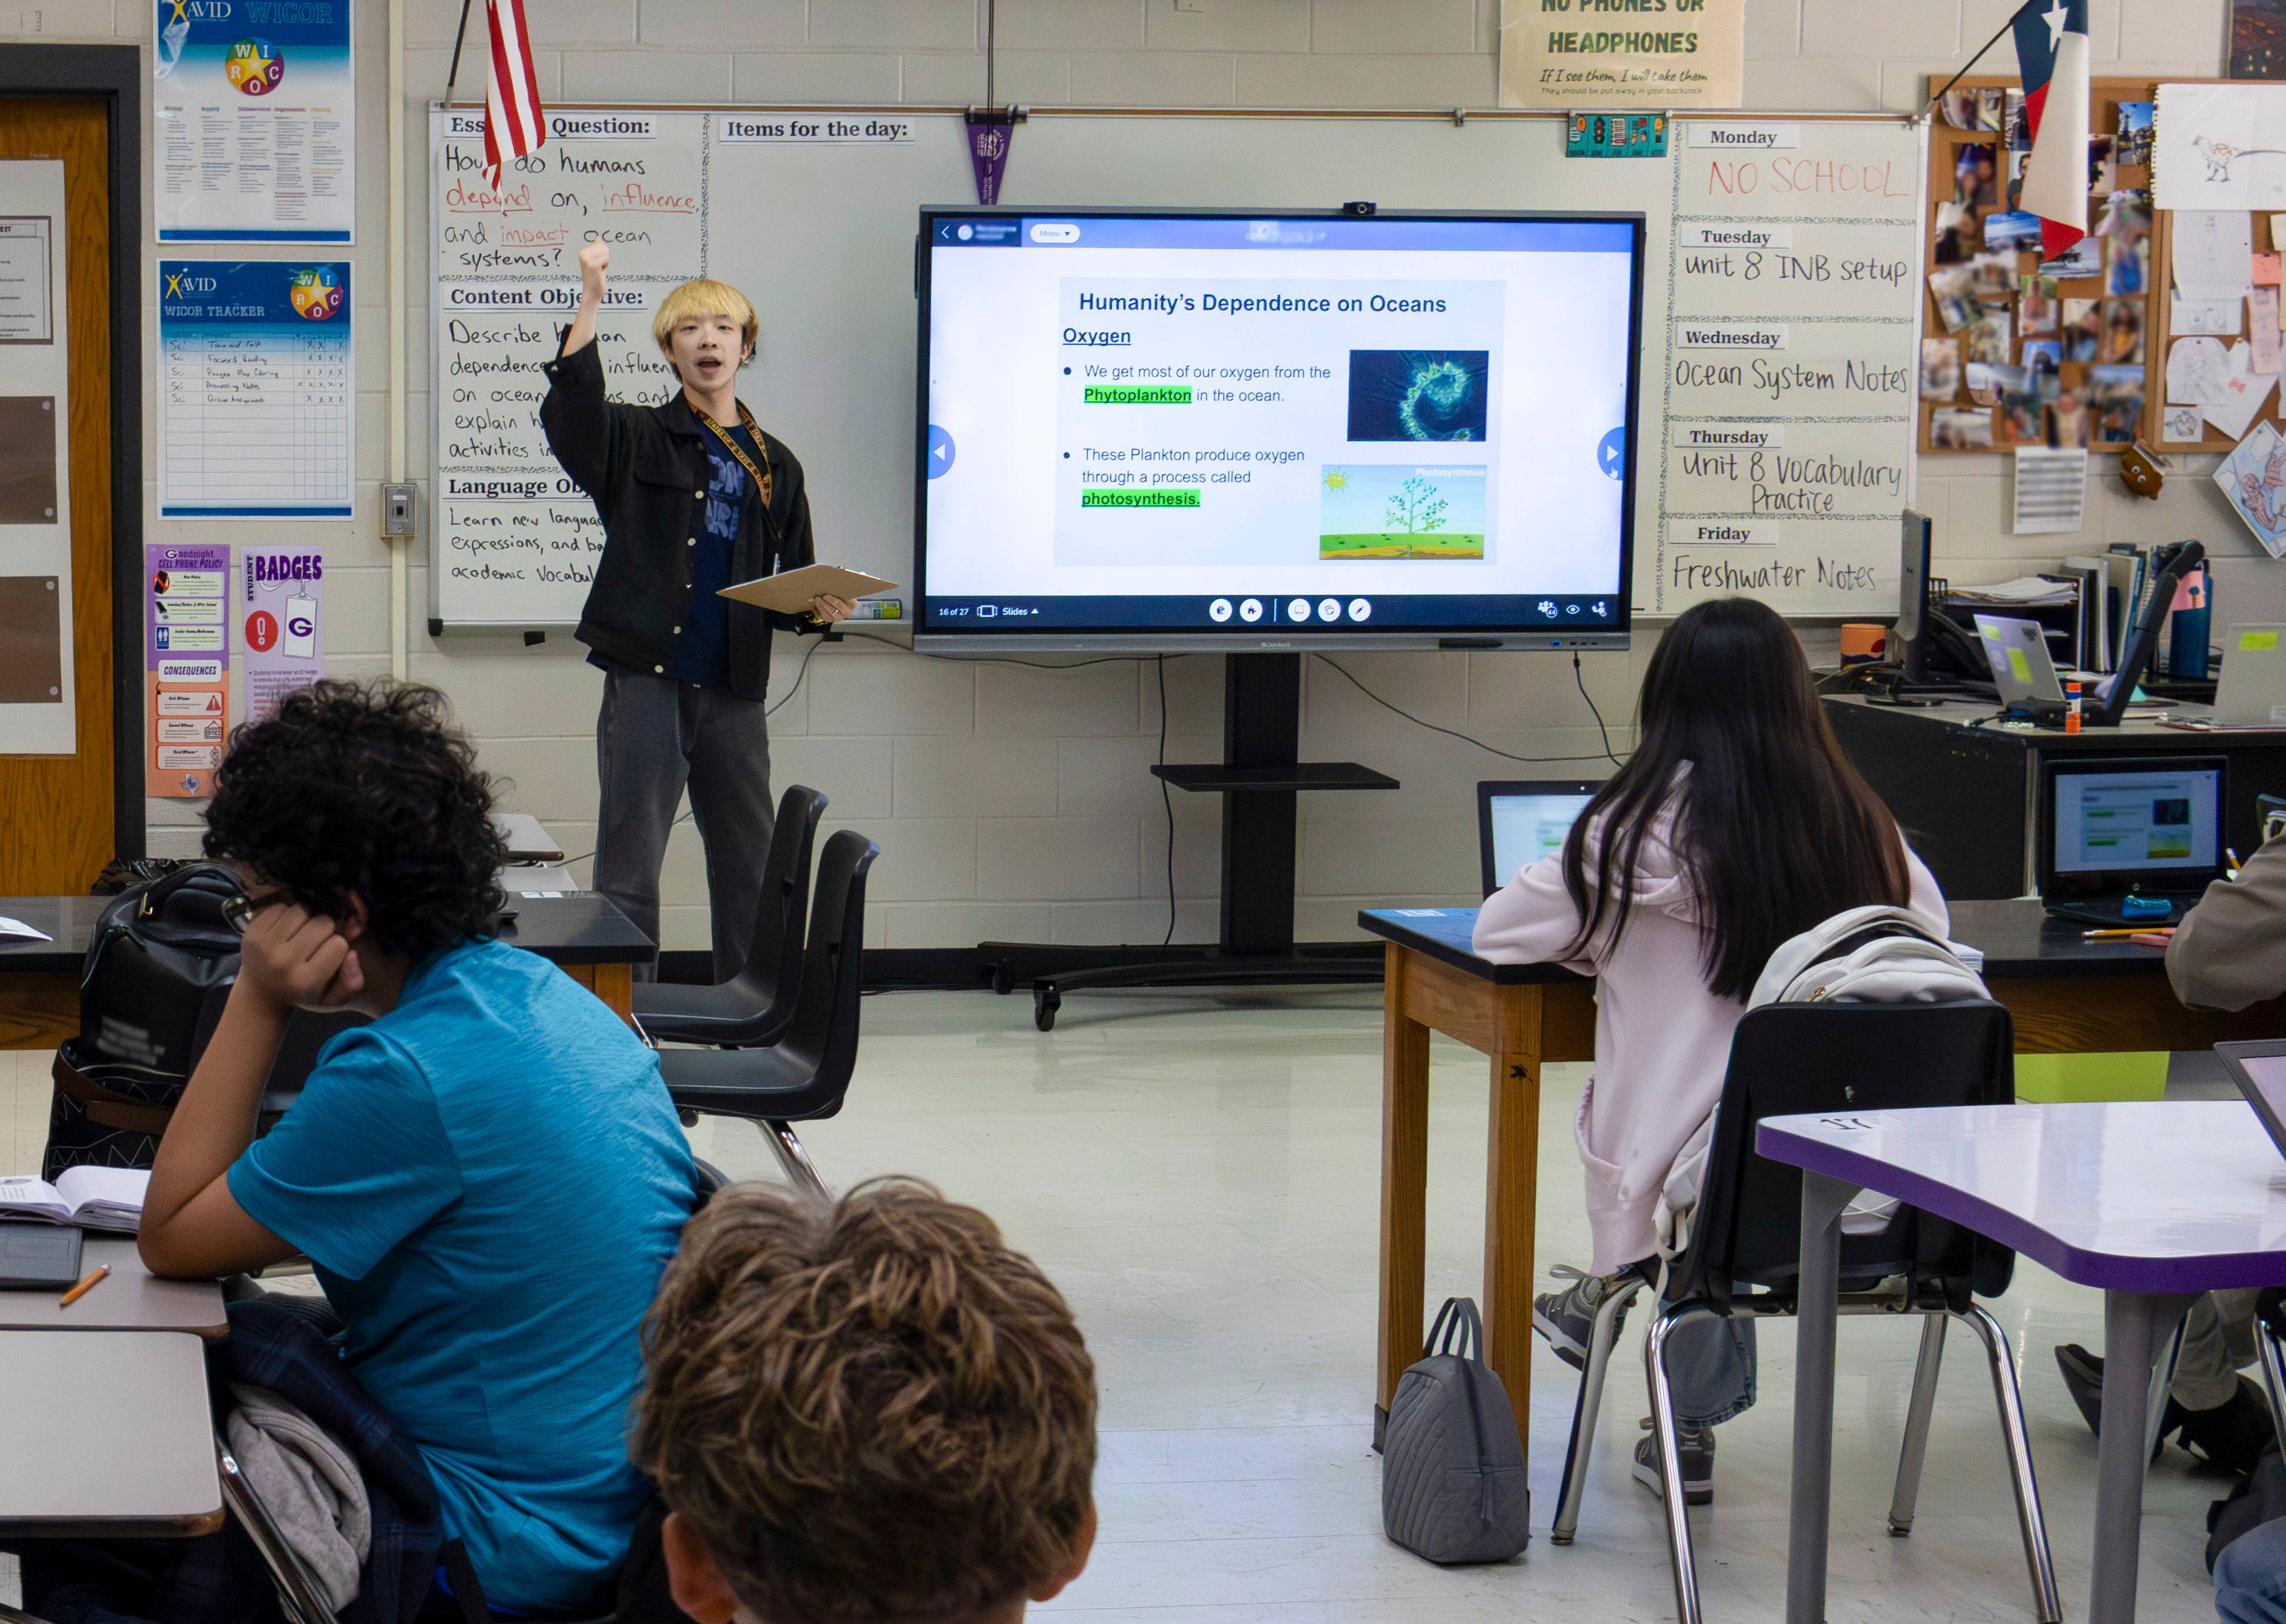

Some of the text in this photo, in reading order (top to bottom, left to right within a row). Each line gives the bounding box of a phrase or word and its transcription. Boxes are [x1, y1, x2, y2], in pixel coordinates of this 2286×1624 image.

[187, 1, 232, 18] AVID
[245, 2, 333, 24] WICOR
[1548, 32, 1698, 53] HEADPHONES
[1631, 69, 1650, 80] will
[1653, 70, 1676, 81] take
[1680, 69, 1707, 81] them
[552, 118, 650, 137] Question:
[728, 122, 907, 140] Items for the day:
[1711, 131, 1777, 147] Monday
[515, 155, 545, 174] do
[560, 147, 646, 175] humans
[1709, 157, 1908, 197] NO SCHOOL
[447, 178, 699, 216] depend on, influence,
[445, 223, 652, 245] and impact ocean
[1701, 230, 1771, 246] Tuesday
[460, 248, 562, 271] systems?
[1745, 251, 1762, 280] 8
[1775, 254, 1831, 281] INB
[1841, 258, 1907, 287] setup
[180, 277, 217, 291] AVID
[451, 288, 643, 308] Content Objetive:
[1203, 294, 1330, 315] Dependence
[1338, 298, 1362, 311] on
[1370, 295, 1446, 313] Oceans
[165, 306, 264, 317] WICOR TRACKER
[449, 319, 626, 344] Describe han
[1062, 328, 1131, 345] Oxygen
[1686, 331, 1780, 348] Wednesday
[450, 353, 671, 377] dependence influen
[1085, 365, 1330, 381] We get most of our oxygen from the
[1676, 358, 1908, 400] Ocean System Notes
[491, 391, 545, 402] ocean
[638, 385, 669, 405] and
[1084, 388, 1284, 403] Phytoplankton in the ocean.
[455, 408, 517, 434] explain
[450, 438, 529, 458] activities
[1690, 431, 1768, 447] Thursday
[1084, 448, 1305, 464] These Plankton produce oxygen
[1415, 468, 1486, 478] Photosynthesis
[1751, 452, 1765, 482] 8
[449, 479, 547, 498] Language
[1082, 471, 1250, 486] through a process called
[1082, 492, 1200, 506] photosynthesis.
[1752, 484, 1834, 514] Practice
[450, 508, 603, 533] Learn new langua
[451, 535, 544, 556] expressions,
[551, 538, 580, 552] and
[1698, 528, 1750, 543] Friday
[256, 555, 322, 581] BADGES
[451, 563, 594, 582] academic Vocabul
[1674, 555, 1876, 590] Freshwater Notes
[1003, 608, 1028, 616] Slides
[289, 617, 313, 637] G
[164, 666, 217, 676] CONSEQUENCES
